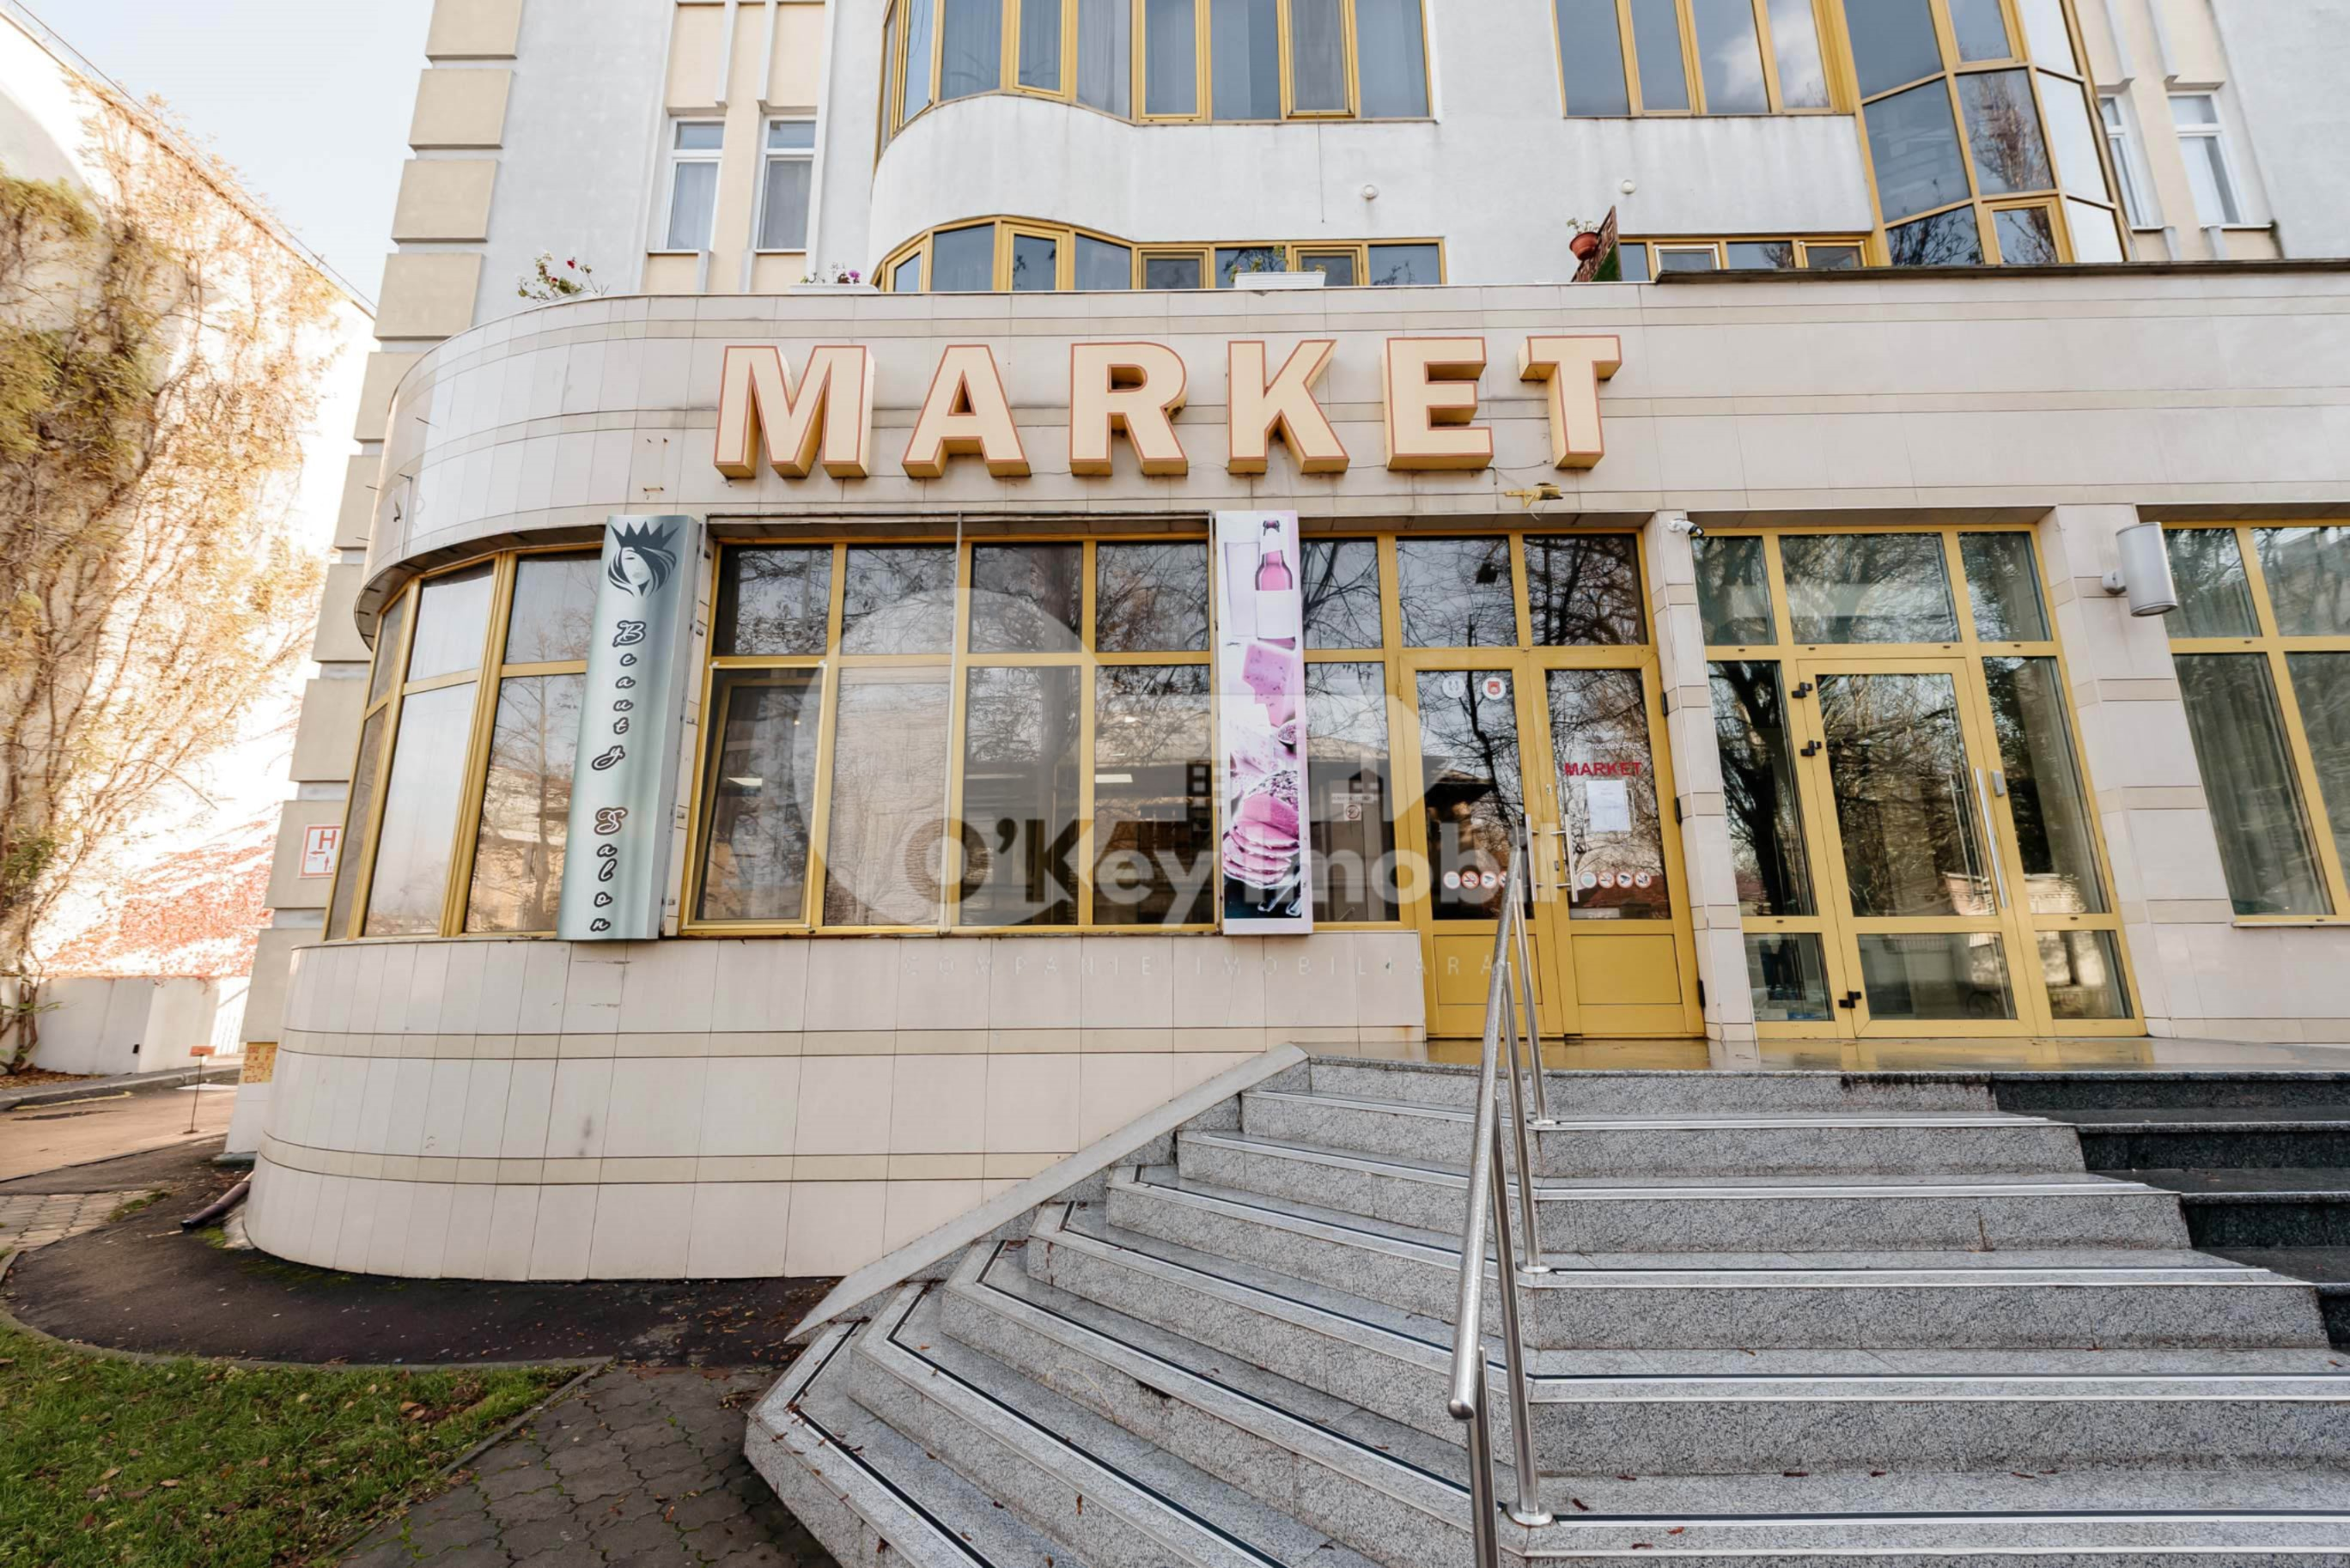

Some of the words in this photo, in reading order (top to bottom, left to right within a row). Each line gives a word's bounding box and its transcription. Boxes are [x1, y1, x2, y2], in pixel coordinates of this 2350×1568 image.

[714, 335, 1622, 477] MARKET
[592, 620, 647, 770] Beauty
[1564, 762, 1641, 776] MARKET
[319, 830, 337, 849] H
[590, 807, 628, 932] Salon
